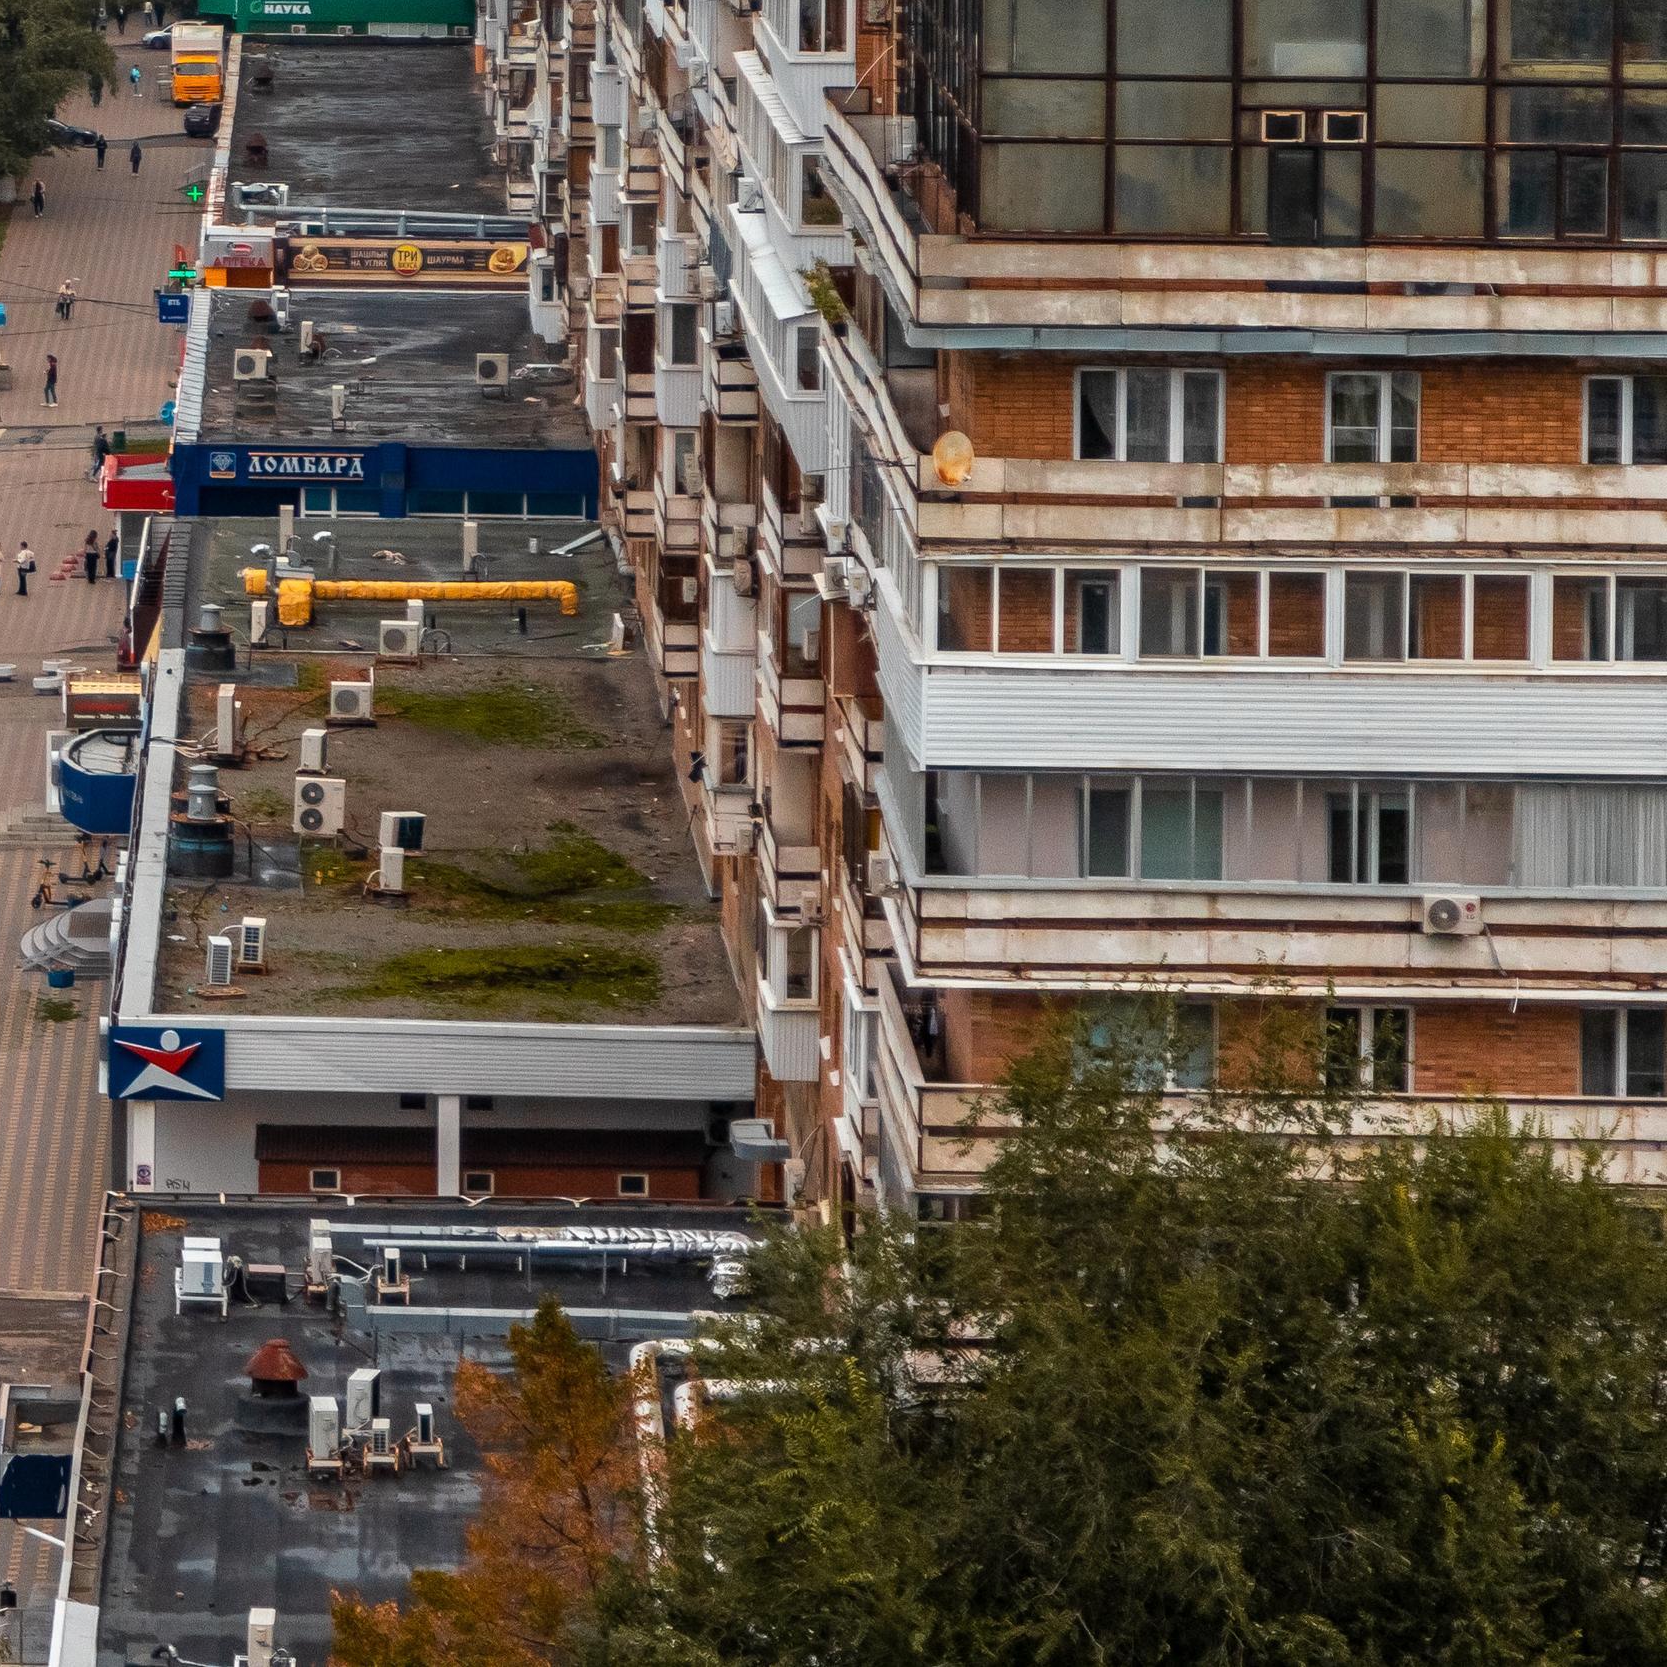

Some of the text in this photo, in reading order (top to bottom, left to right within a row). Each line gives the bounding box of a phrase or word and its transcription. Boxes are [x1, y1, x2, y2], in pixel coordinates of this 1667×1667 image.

[264, 4, 311, 14] НАУКА
[398, 250, 417, 261] ТРИ
[427, 255, 465, 264] ШАУРМА
[214, 257, 265, 266] АПТЕКА
[248, 456, 364, 477] ЛОМБАРД
